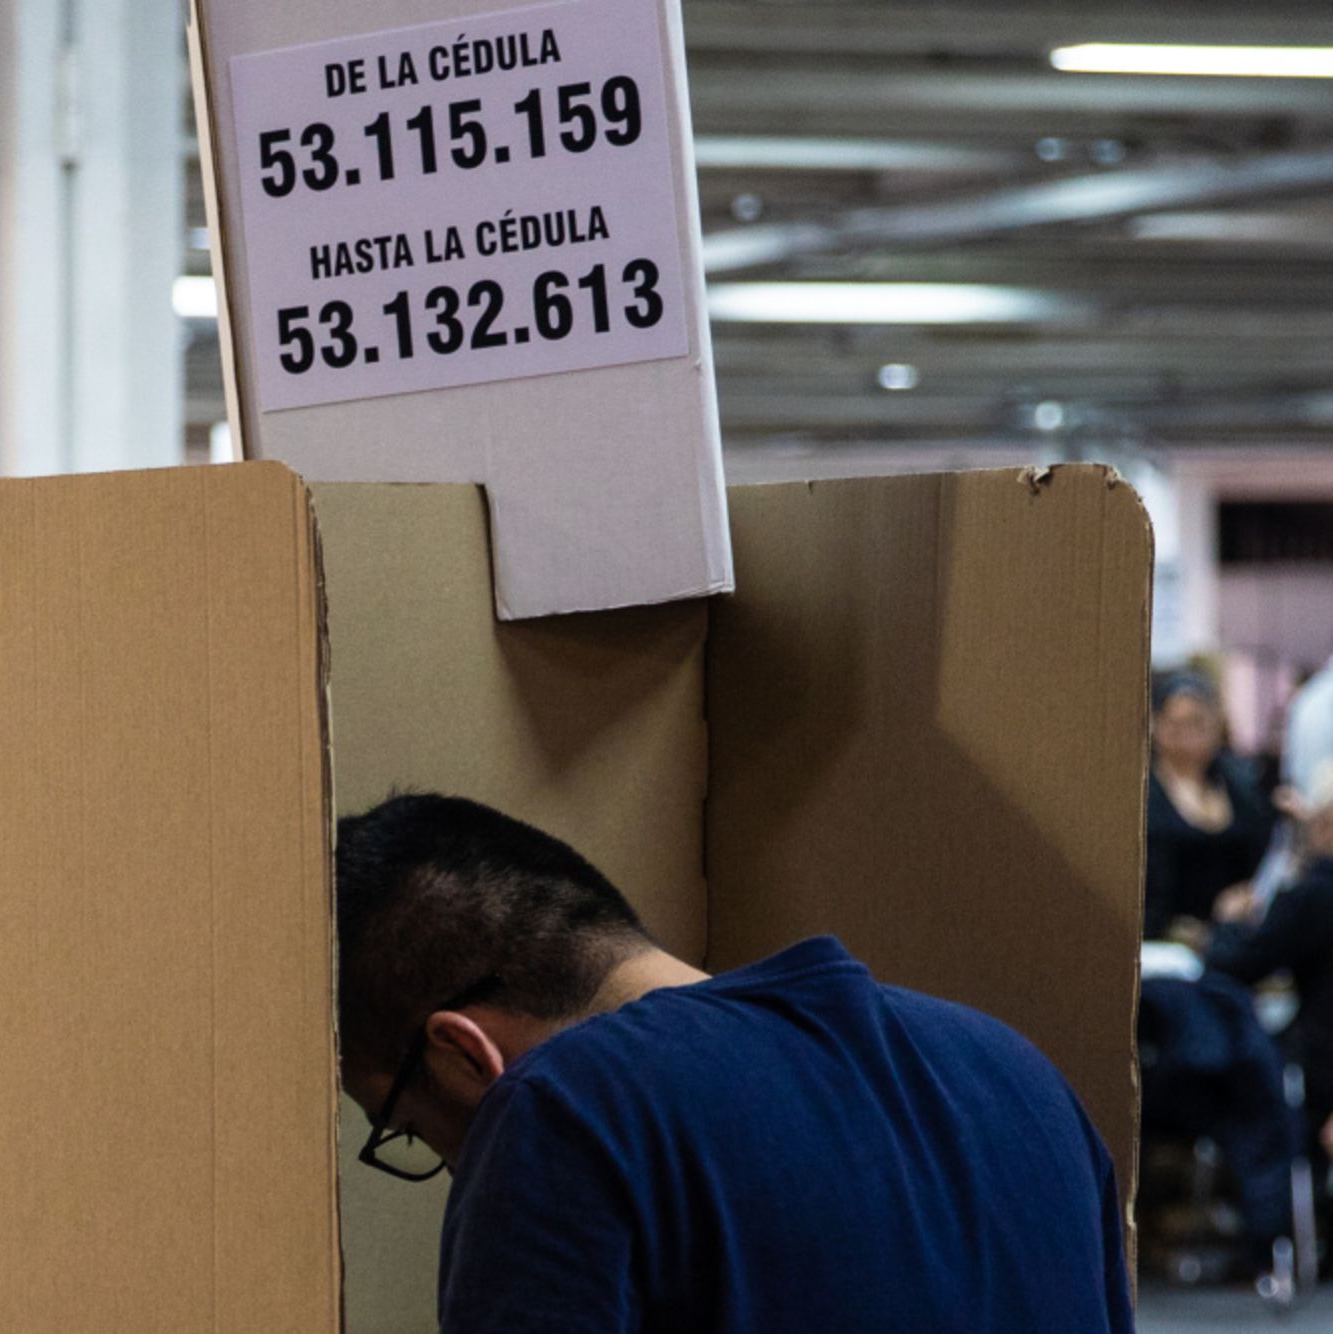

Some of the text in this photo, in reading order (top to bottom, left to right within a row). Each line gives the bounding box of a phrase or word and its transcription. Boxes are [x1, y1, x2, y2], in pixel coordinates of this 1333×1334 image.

[325, 29, 561, 98] DE LA CÉDULA
[258, 75, 643, 198] 53.115.159
[310, 205, 610, 280] HASTA LA CÉDULA
[276, 257, 665, 375] 53.132.613
